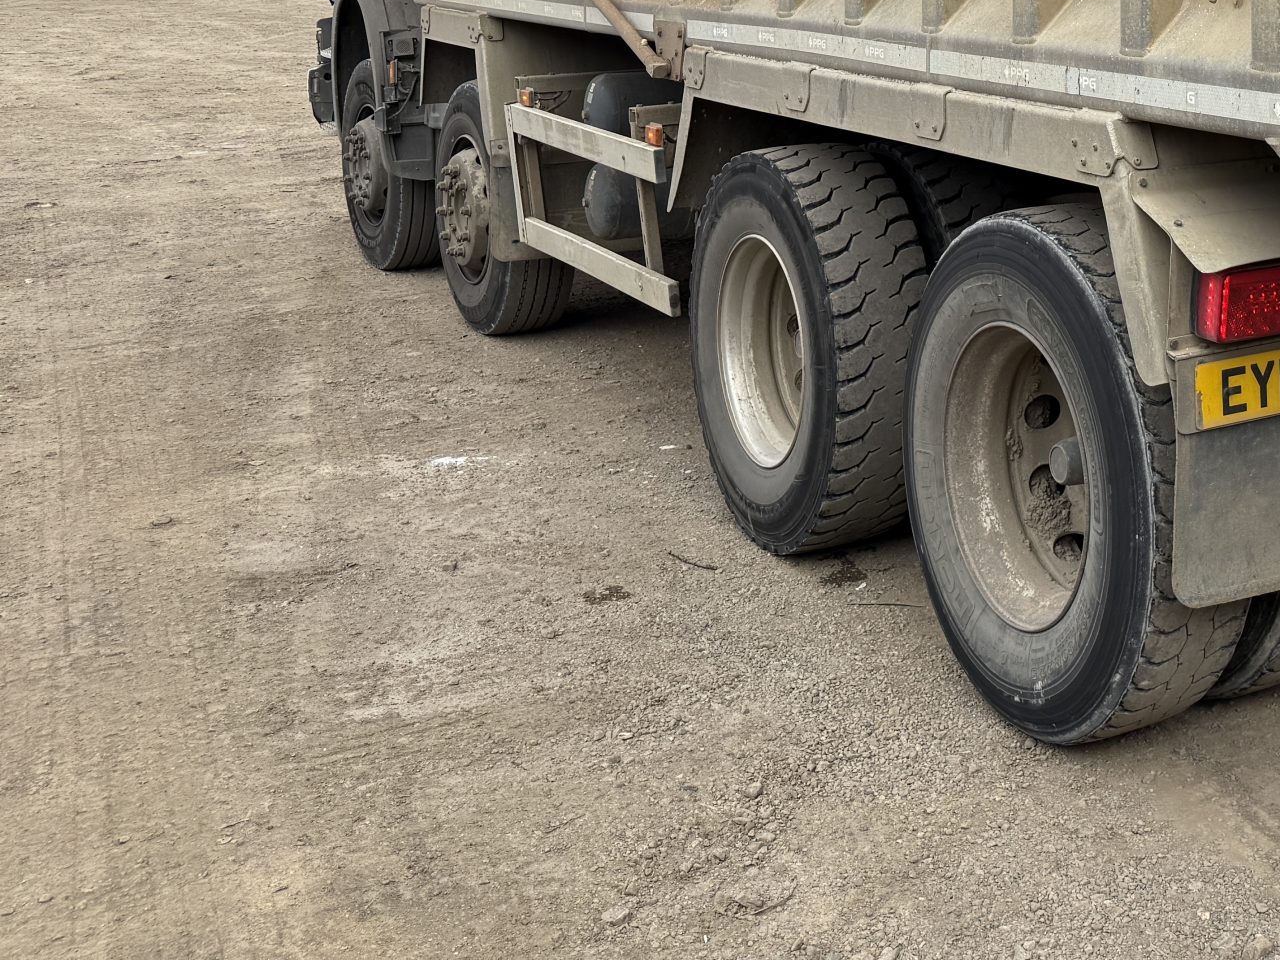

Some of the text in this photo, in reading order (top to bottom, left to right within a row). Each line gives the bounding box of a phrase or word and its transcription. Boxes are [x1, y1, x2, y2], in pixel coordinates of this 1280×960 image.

[762, 32, 775, 43] PPG
[813, 38, 826, 49] PPG
[869, 46, 885, 59] PPG
[1010, 67, 1030, 81] PPG
